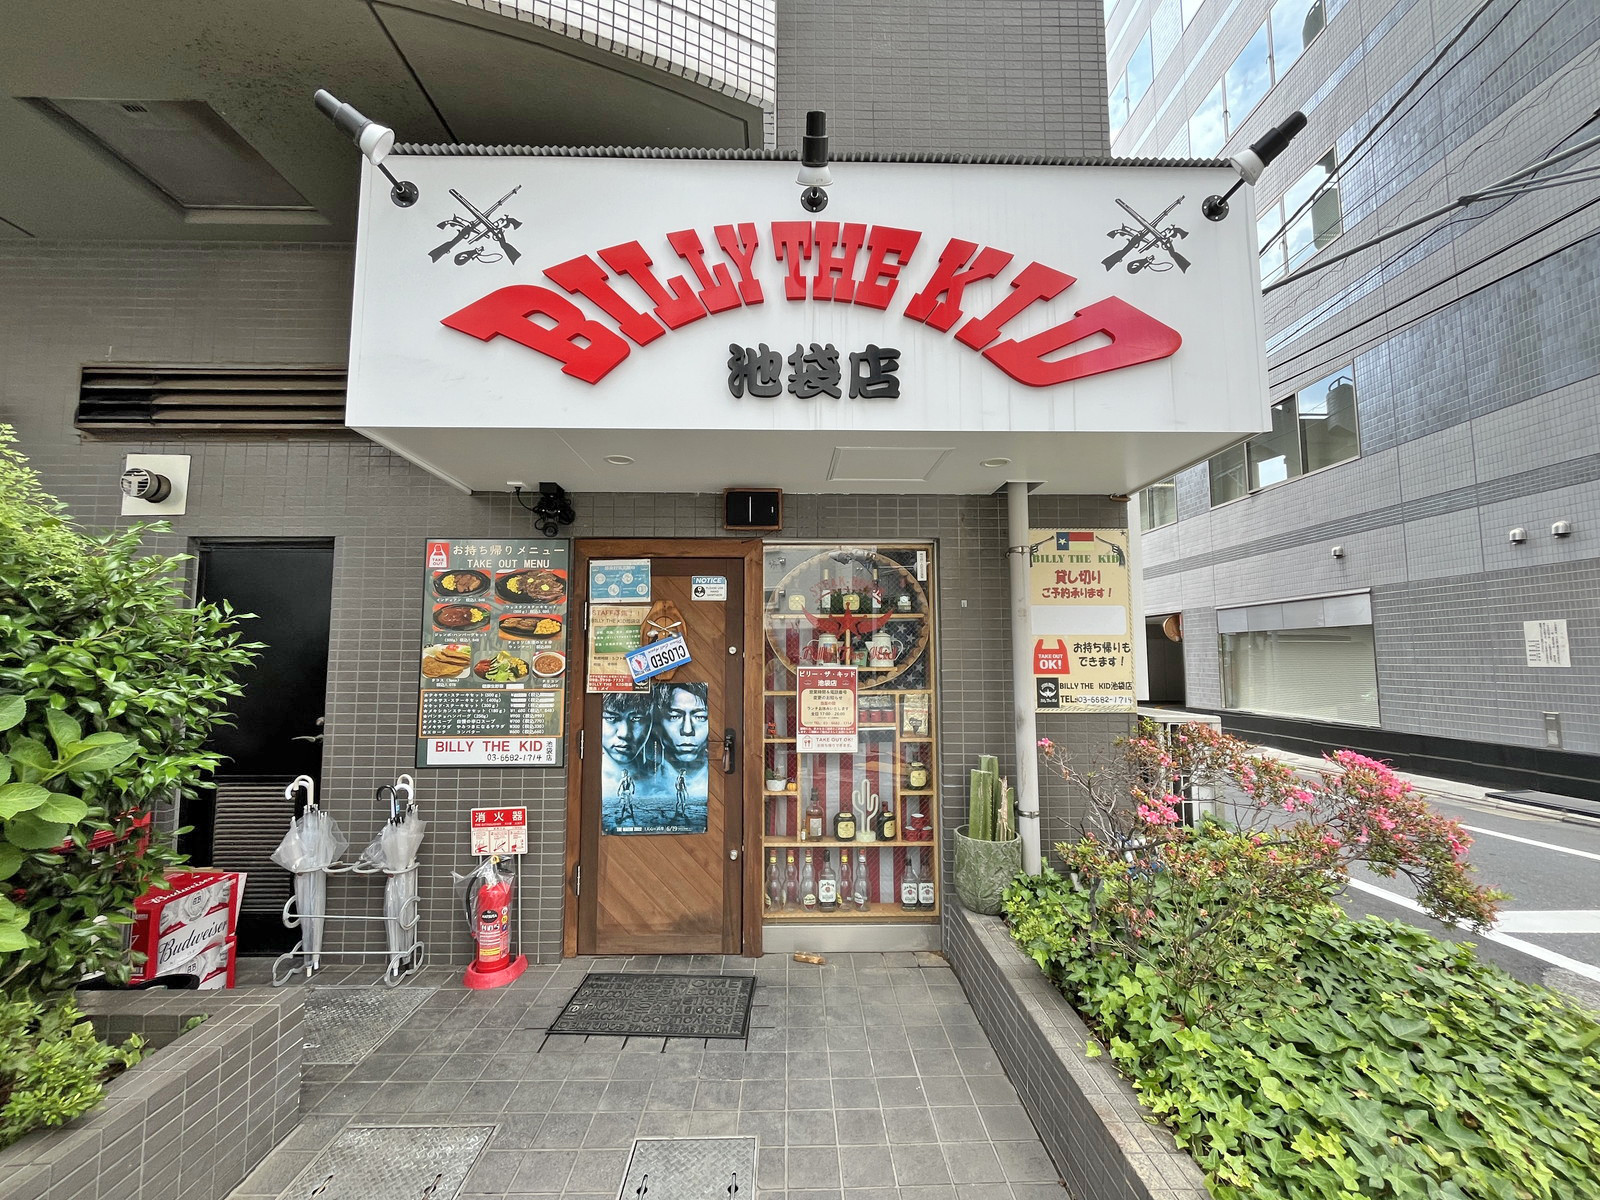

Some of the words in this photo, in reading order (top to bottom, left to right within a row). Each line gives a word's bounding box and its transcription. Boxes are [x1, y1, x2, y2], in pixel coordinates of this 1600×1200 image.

[440, 222, 765, 385] BILLY
[770, 220, 922, 310] THE
[904, 237, 1182, 387] KID
[728, 342, 902, 400] 池袋店
[453, 545, 565, 556] お持ち帰りメニュー
[467, 559, 492, 568] TAKE
[498, 559, 518, 568] OUT
[524, 559, 550, 568] MENU
[1033, 554, 1065, 563] BILLY
[1068, 554, 1091, 563] THE
[1098, 554, 1121, 563] KID
[1055, 569, 1101, 584] 貸し切り
[1042, 587, 1112, 599] ご予約承ります！
[1073, 642, 1131, 653] お持ち帰りも
[651, 645, 686, 668] CLOSED
[1079, 656, 1124, 667] できます！
[1040, 660, 1062, 669] OK!
[435, 741, 474, 752] BILLY
[482, 741, 510, 752] THE
[519, 741, 543, 752] KID
[487, 754, 542, 762] 03-6682-1714
[475, 811, 522, 822] 消火器
[142, 877, 214, 904] Budweiser
[159, 921, 227, 965] Budweiser
[579, 989, 642, 997] WELCOME
[672, 987, 737, 996] WELCOME
